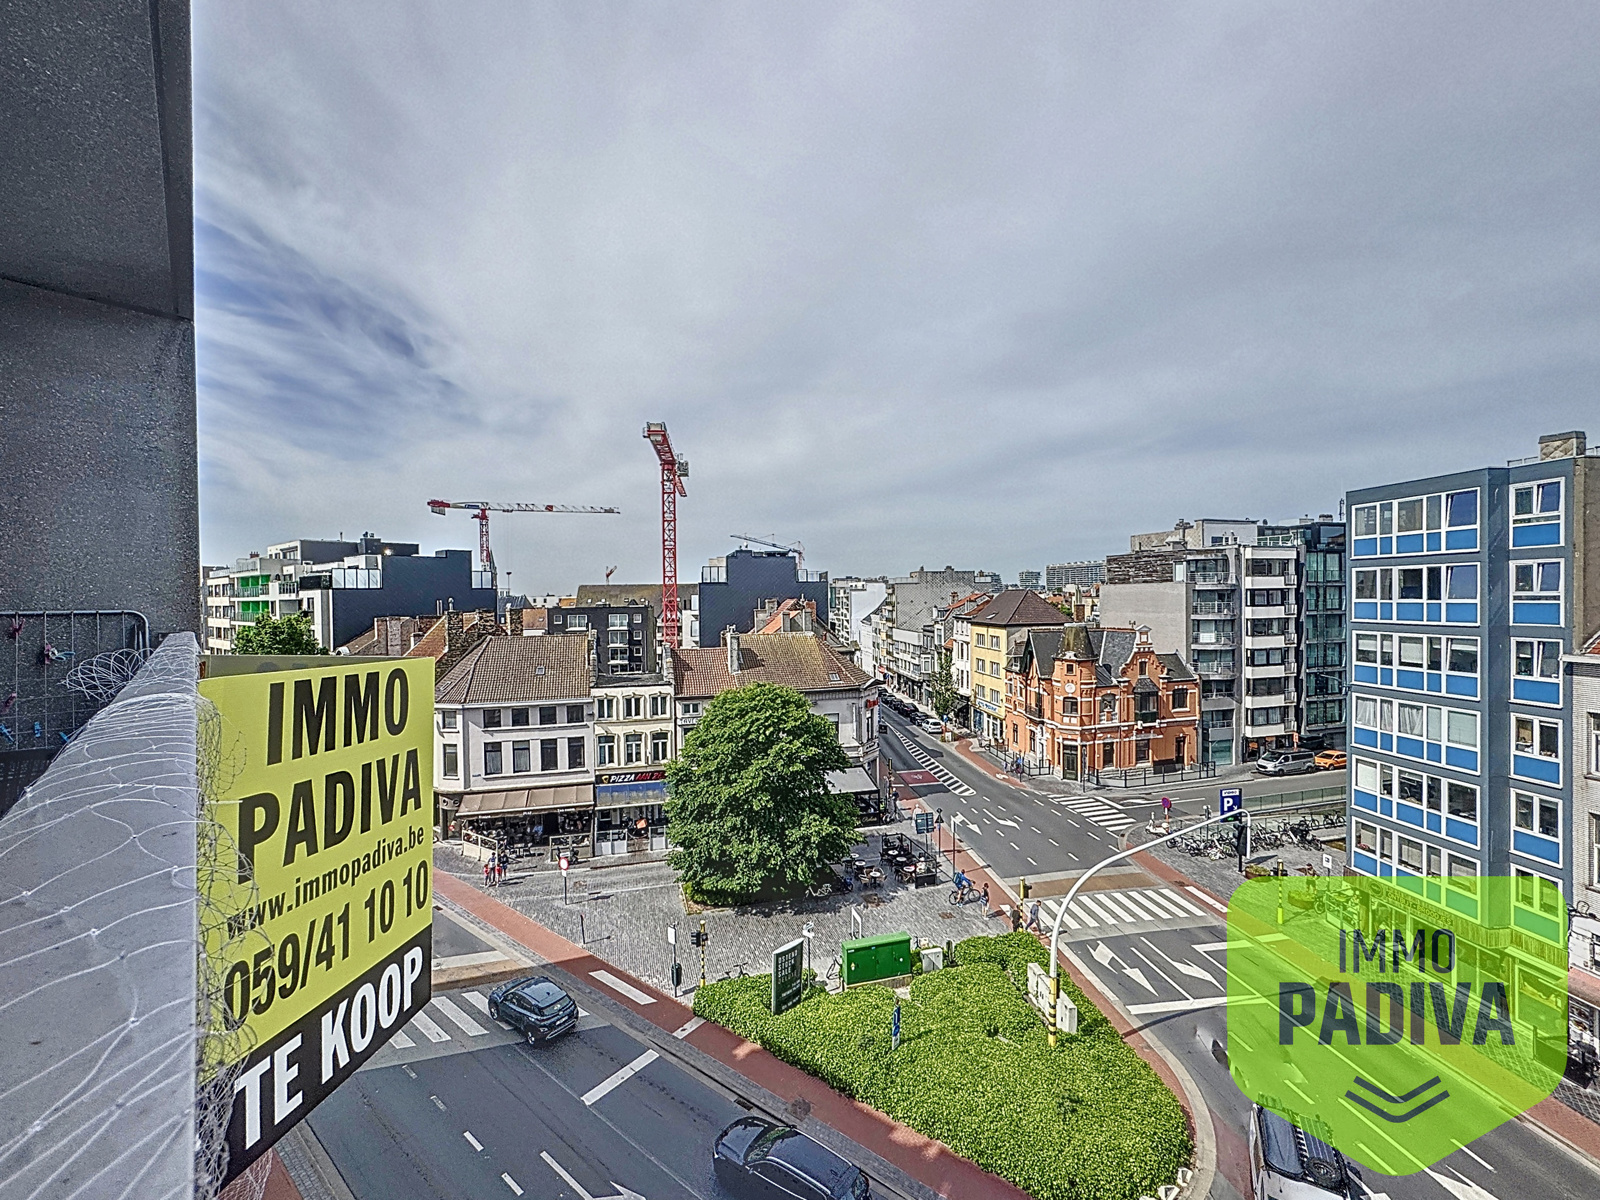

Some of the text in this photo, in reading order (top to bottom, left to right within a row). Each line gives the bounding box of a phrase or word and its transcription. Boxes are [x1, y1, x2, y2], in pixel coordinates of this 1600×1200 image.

[267, 668, 409, 766] IMMO
[238, 748, 422, 885] PADIVA
[610, 774, 634, 782] PIZZA
[1224, 798, 1233, 811] P
[226, 827, 424, 940] www.immopadiva.be
[223, 861, 428, 1031] 059/41 10 10
[778, 966, 791, 978] SALE
[235, 946, 423, 1150] TE KOOP
